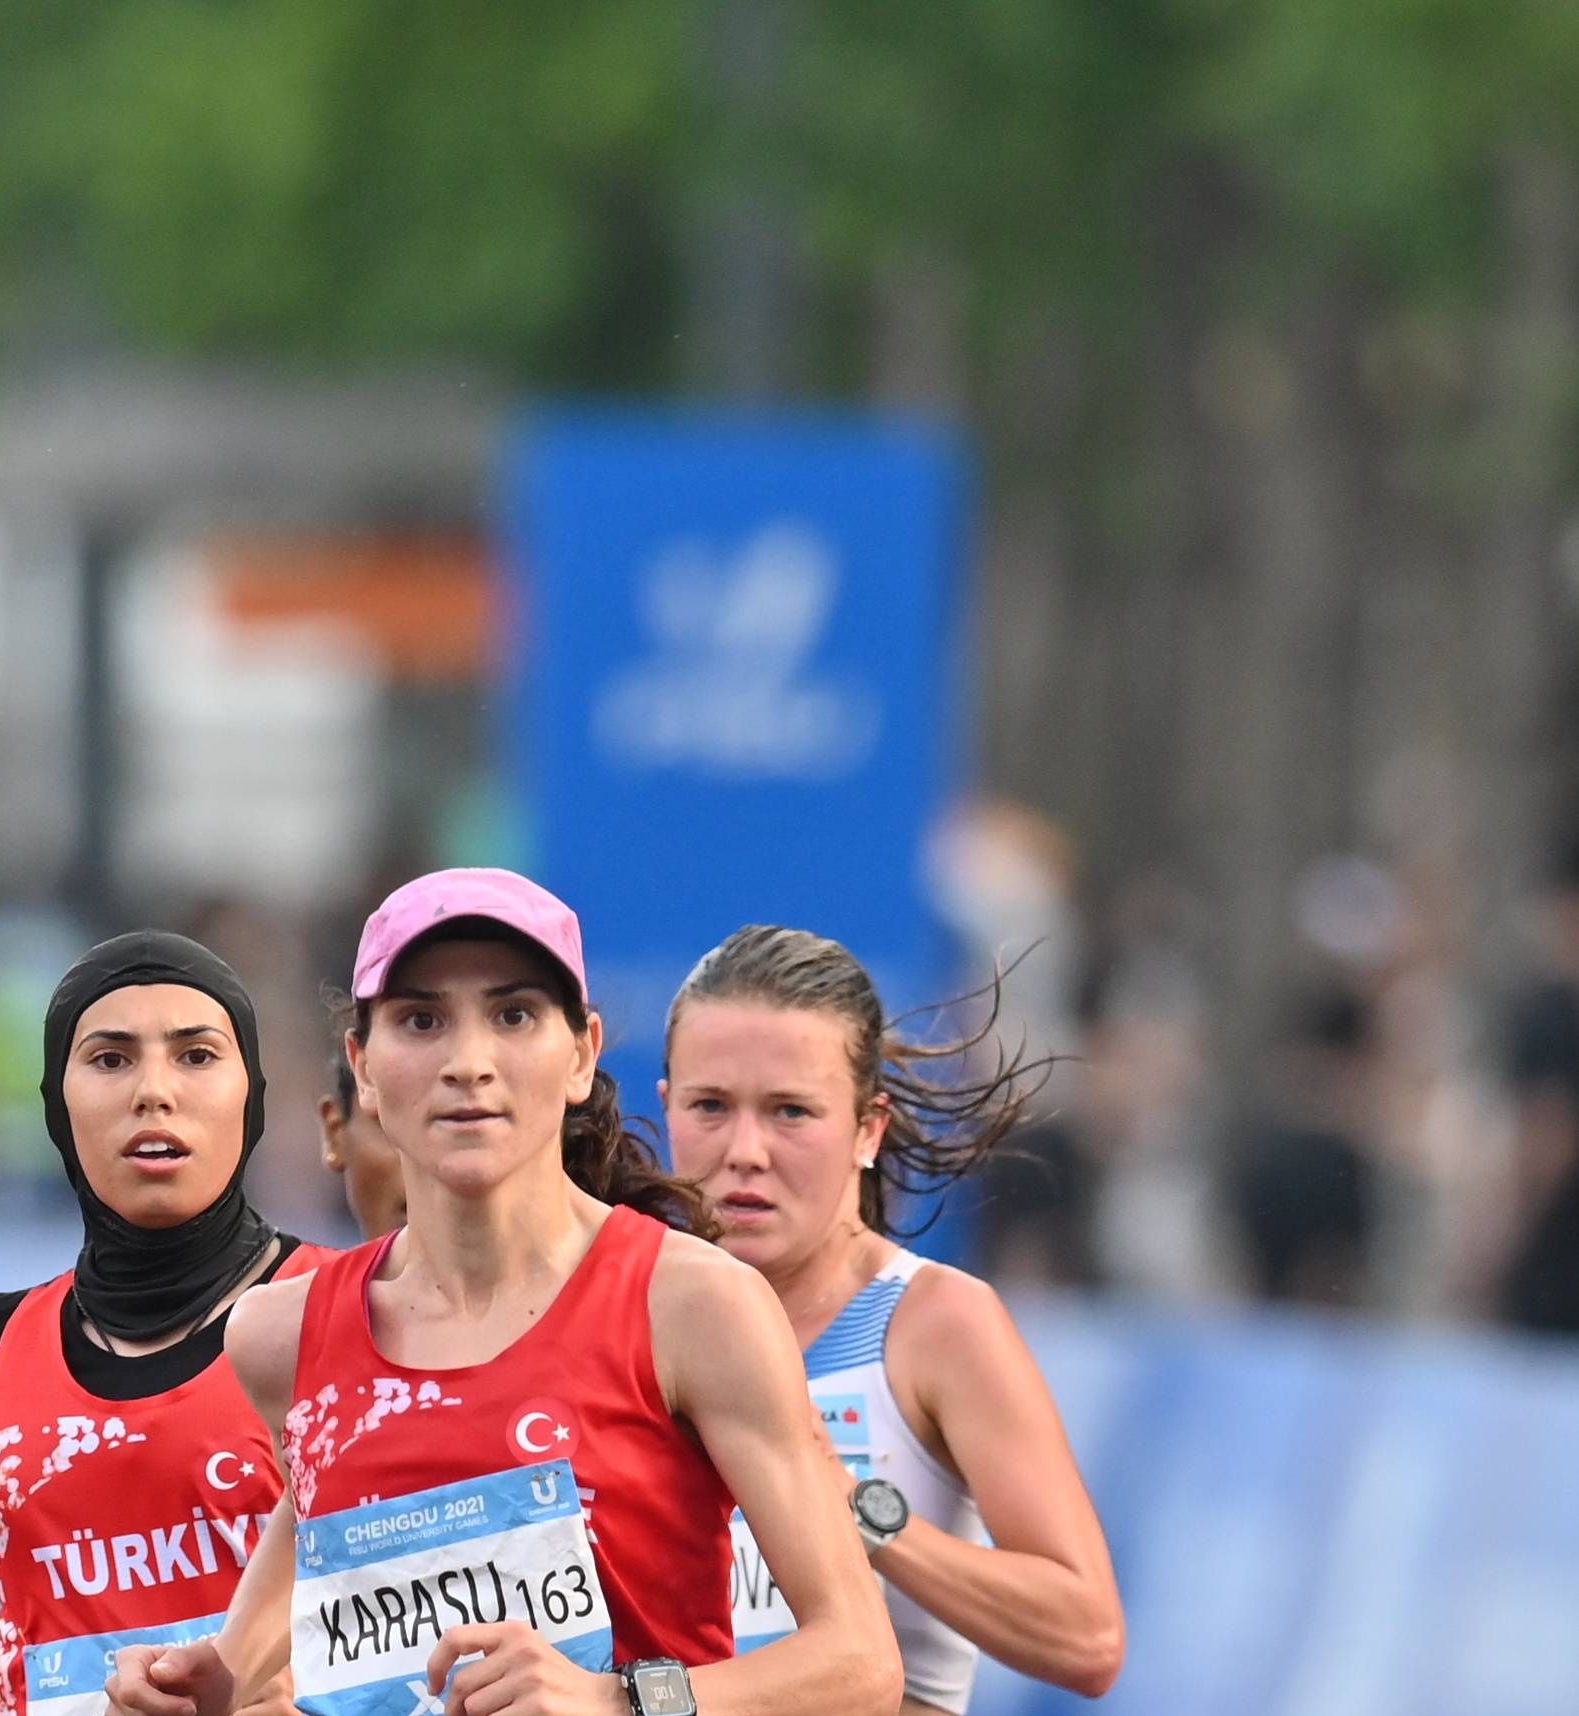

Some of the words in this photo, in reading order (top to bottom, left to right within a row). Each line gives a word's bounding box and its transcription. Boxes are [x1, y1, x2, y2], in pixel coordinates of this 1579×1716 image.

[30, 1506, 277, 1600] TÜRKİY
[344, 1507, 439, 1544] CHENGDU
[444, 1494, 485, 1520] 2021
[319, 1560, 507, 1667] KARASU
[515, 1565, 593, 1630] 163
[39, 1674, 70, 1690] FISU
